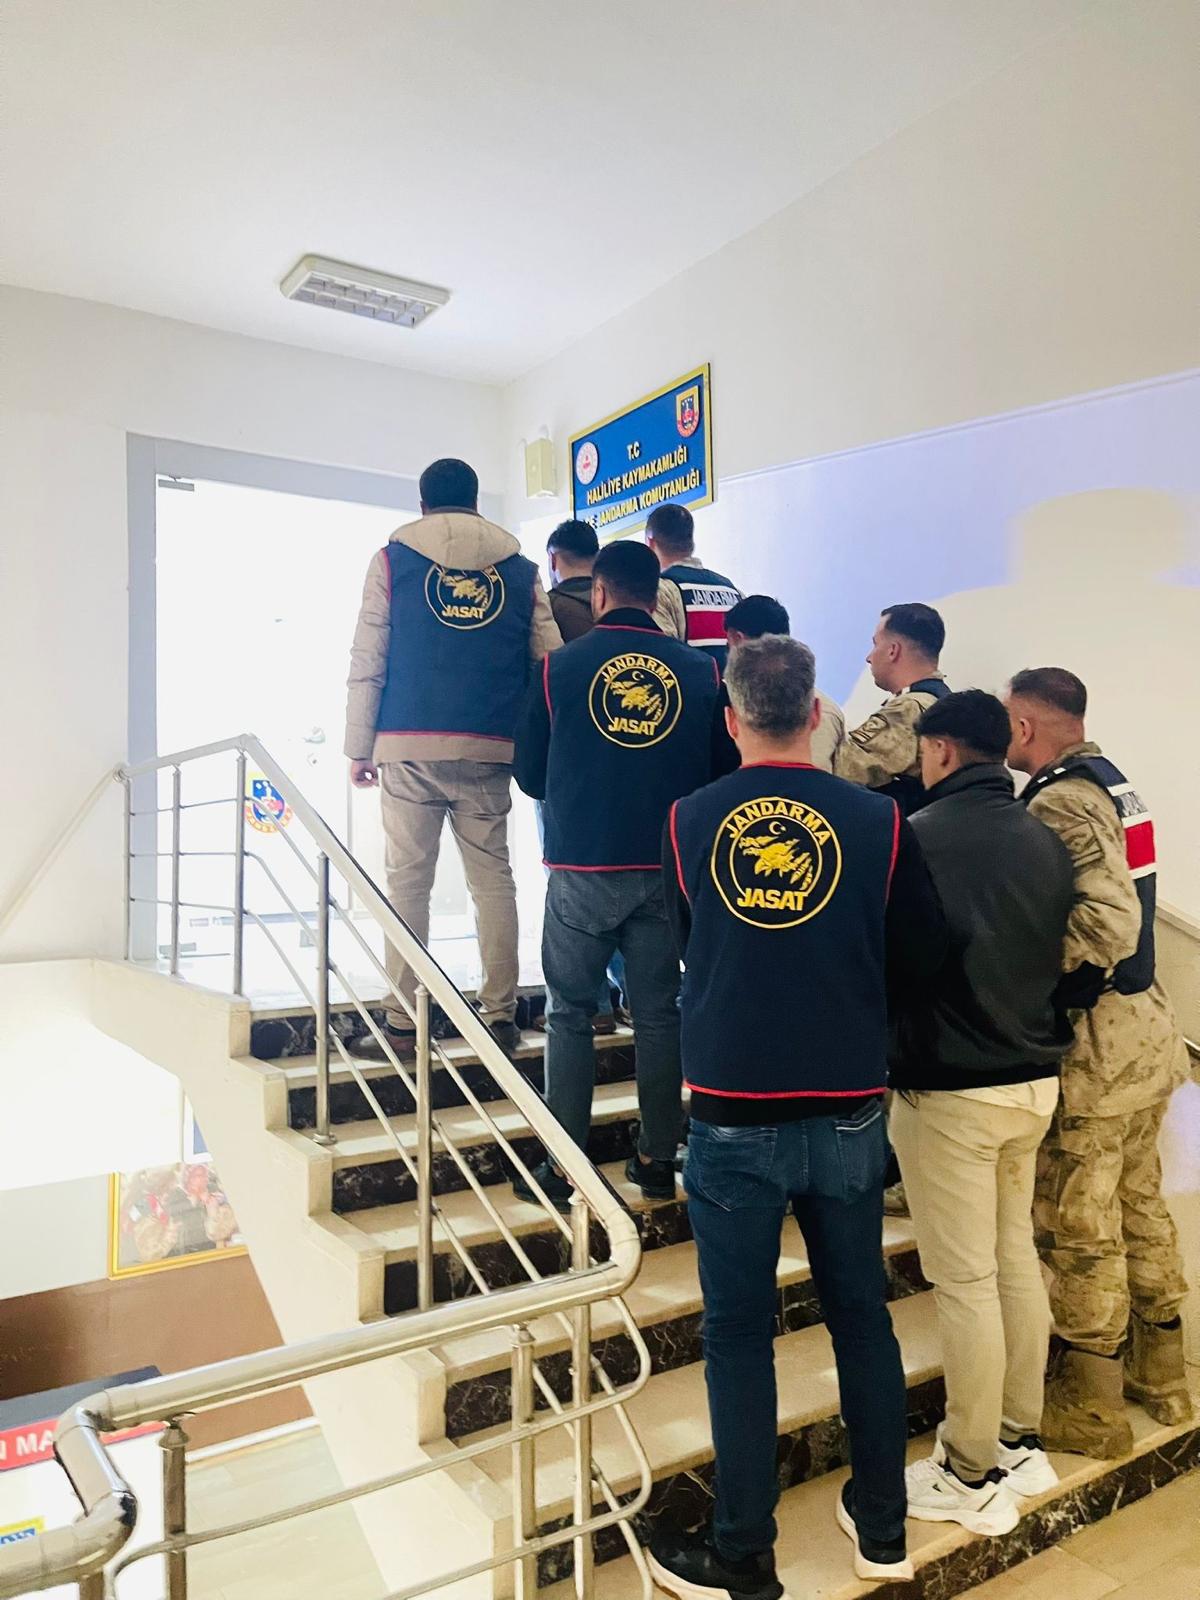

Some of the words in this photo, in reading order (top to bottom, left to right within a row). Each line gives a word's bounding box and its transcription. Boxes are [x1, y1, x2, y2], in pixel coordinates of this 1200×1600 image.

[587, 474, 622, 506] HALİLİYE
[622, 445, 688, 491] KAYMAKAMLIĞI
[639, 469, 700, 509] KOMUTANLIĞI
[442, 605, 486, 619] JASAT
[601, 656, 676, 689] JANDARMA
[608, 717, 658, 735] JASAT
[725, 800, 832, 846] JANDARMA
[737, 888, 808, 911] JASAT
